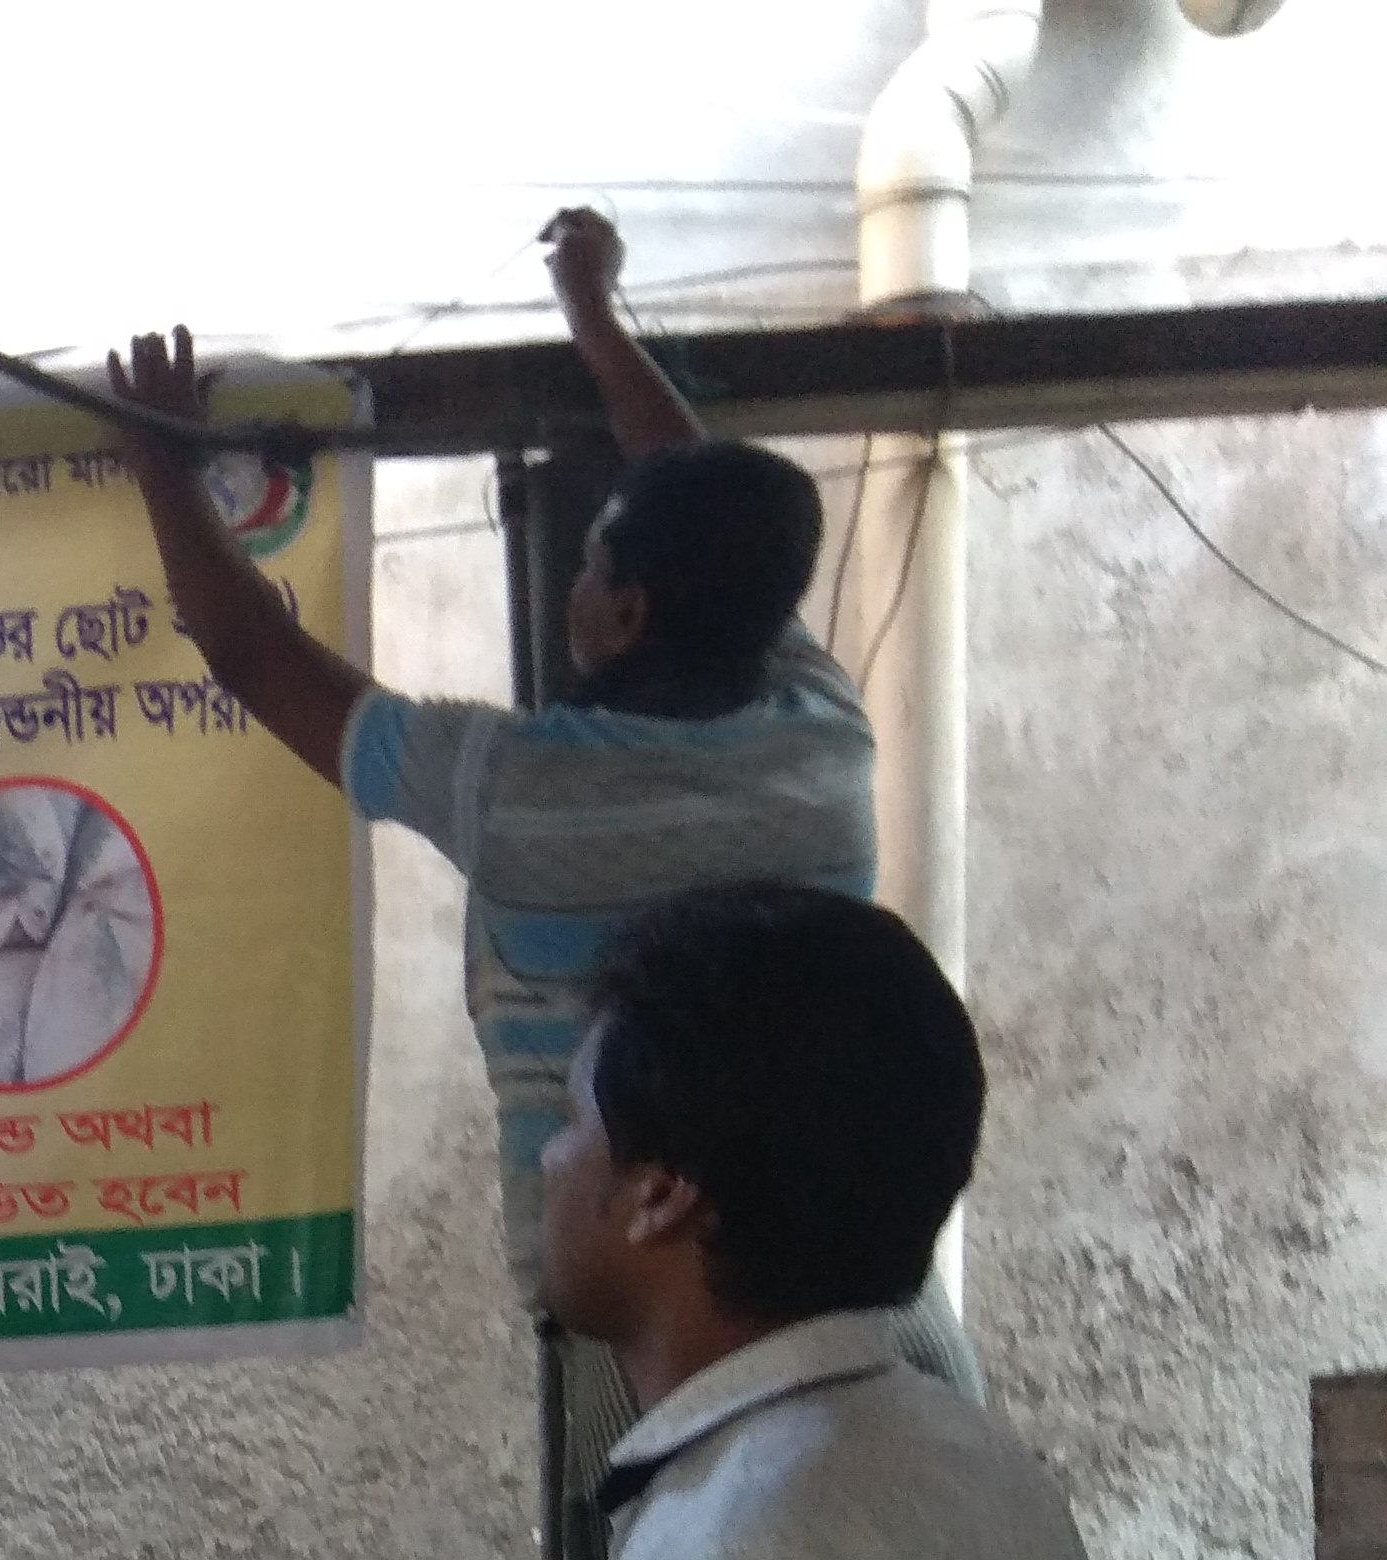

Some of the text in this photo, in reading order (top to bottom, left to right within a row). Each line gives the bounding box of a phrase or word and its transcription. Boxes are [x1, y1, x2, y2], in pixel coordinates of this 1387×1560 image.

[56, 586, 151, 659] ছোট
[133, 676, 250, 737] অপরা
[58, 1100, 221, 1152] অথবা
[96, 1169, 247, 1224] হবেন
[142, 1242, 270, 1303] ঢাকা
